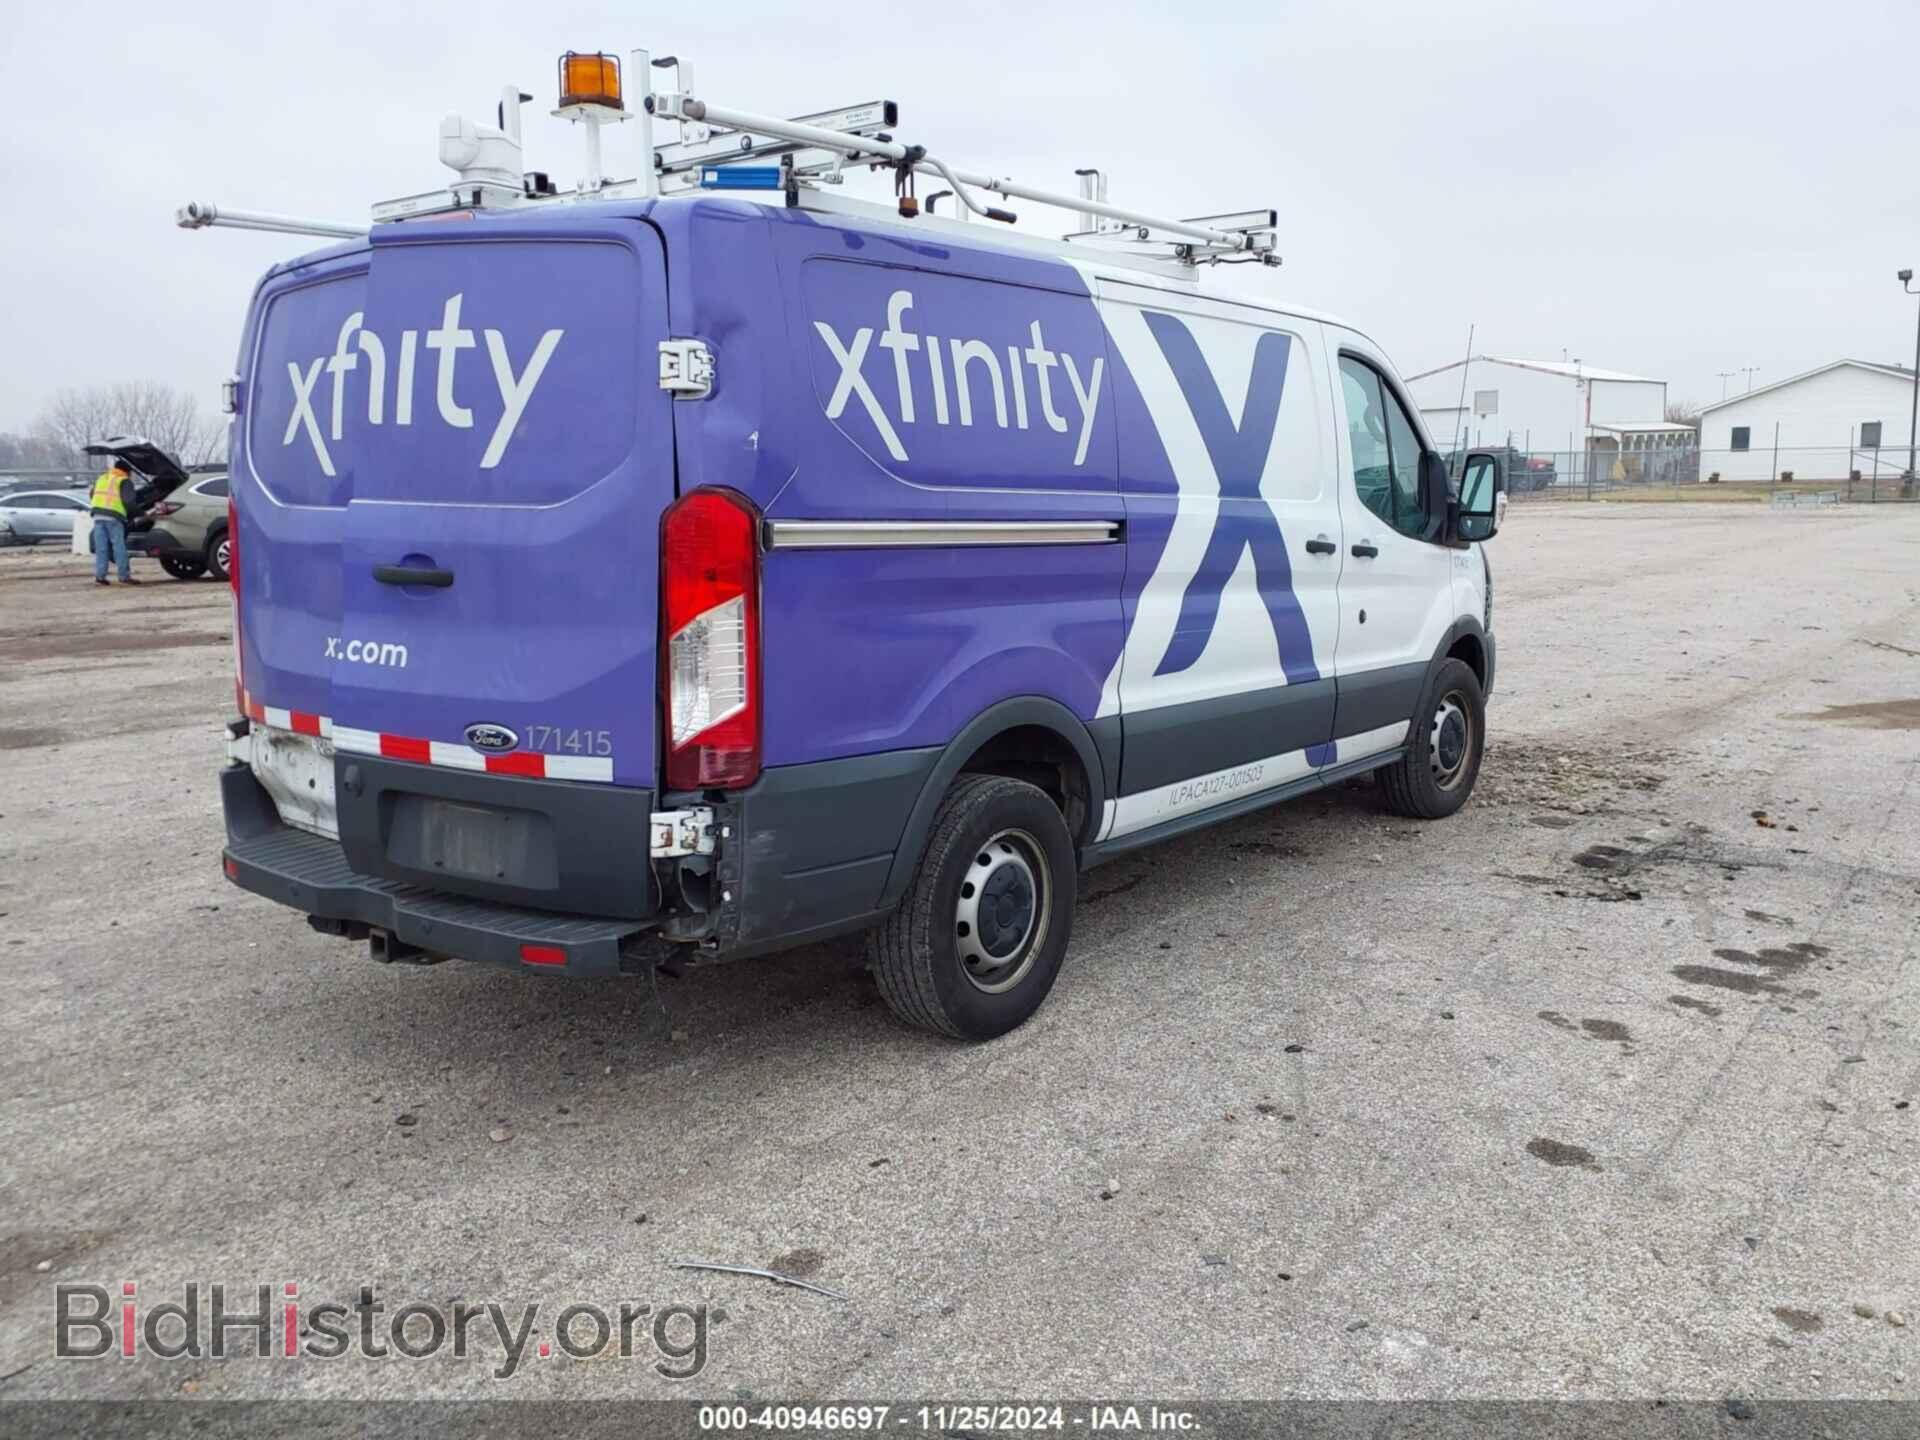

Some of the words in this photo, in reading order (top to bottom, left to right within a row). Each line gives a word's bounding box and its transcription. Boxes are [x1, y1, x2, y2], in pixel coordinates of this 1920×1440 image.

[813, 290, 1104, 466] xfinity
[324, 636, 407, 668] x.com
[525, 725, 612, 756] 171415
